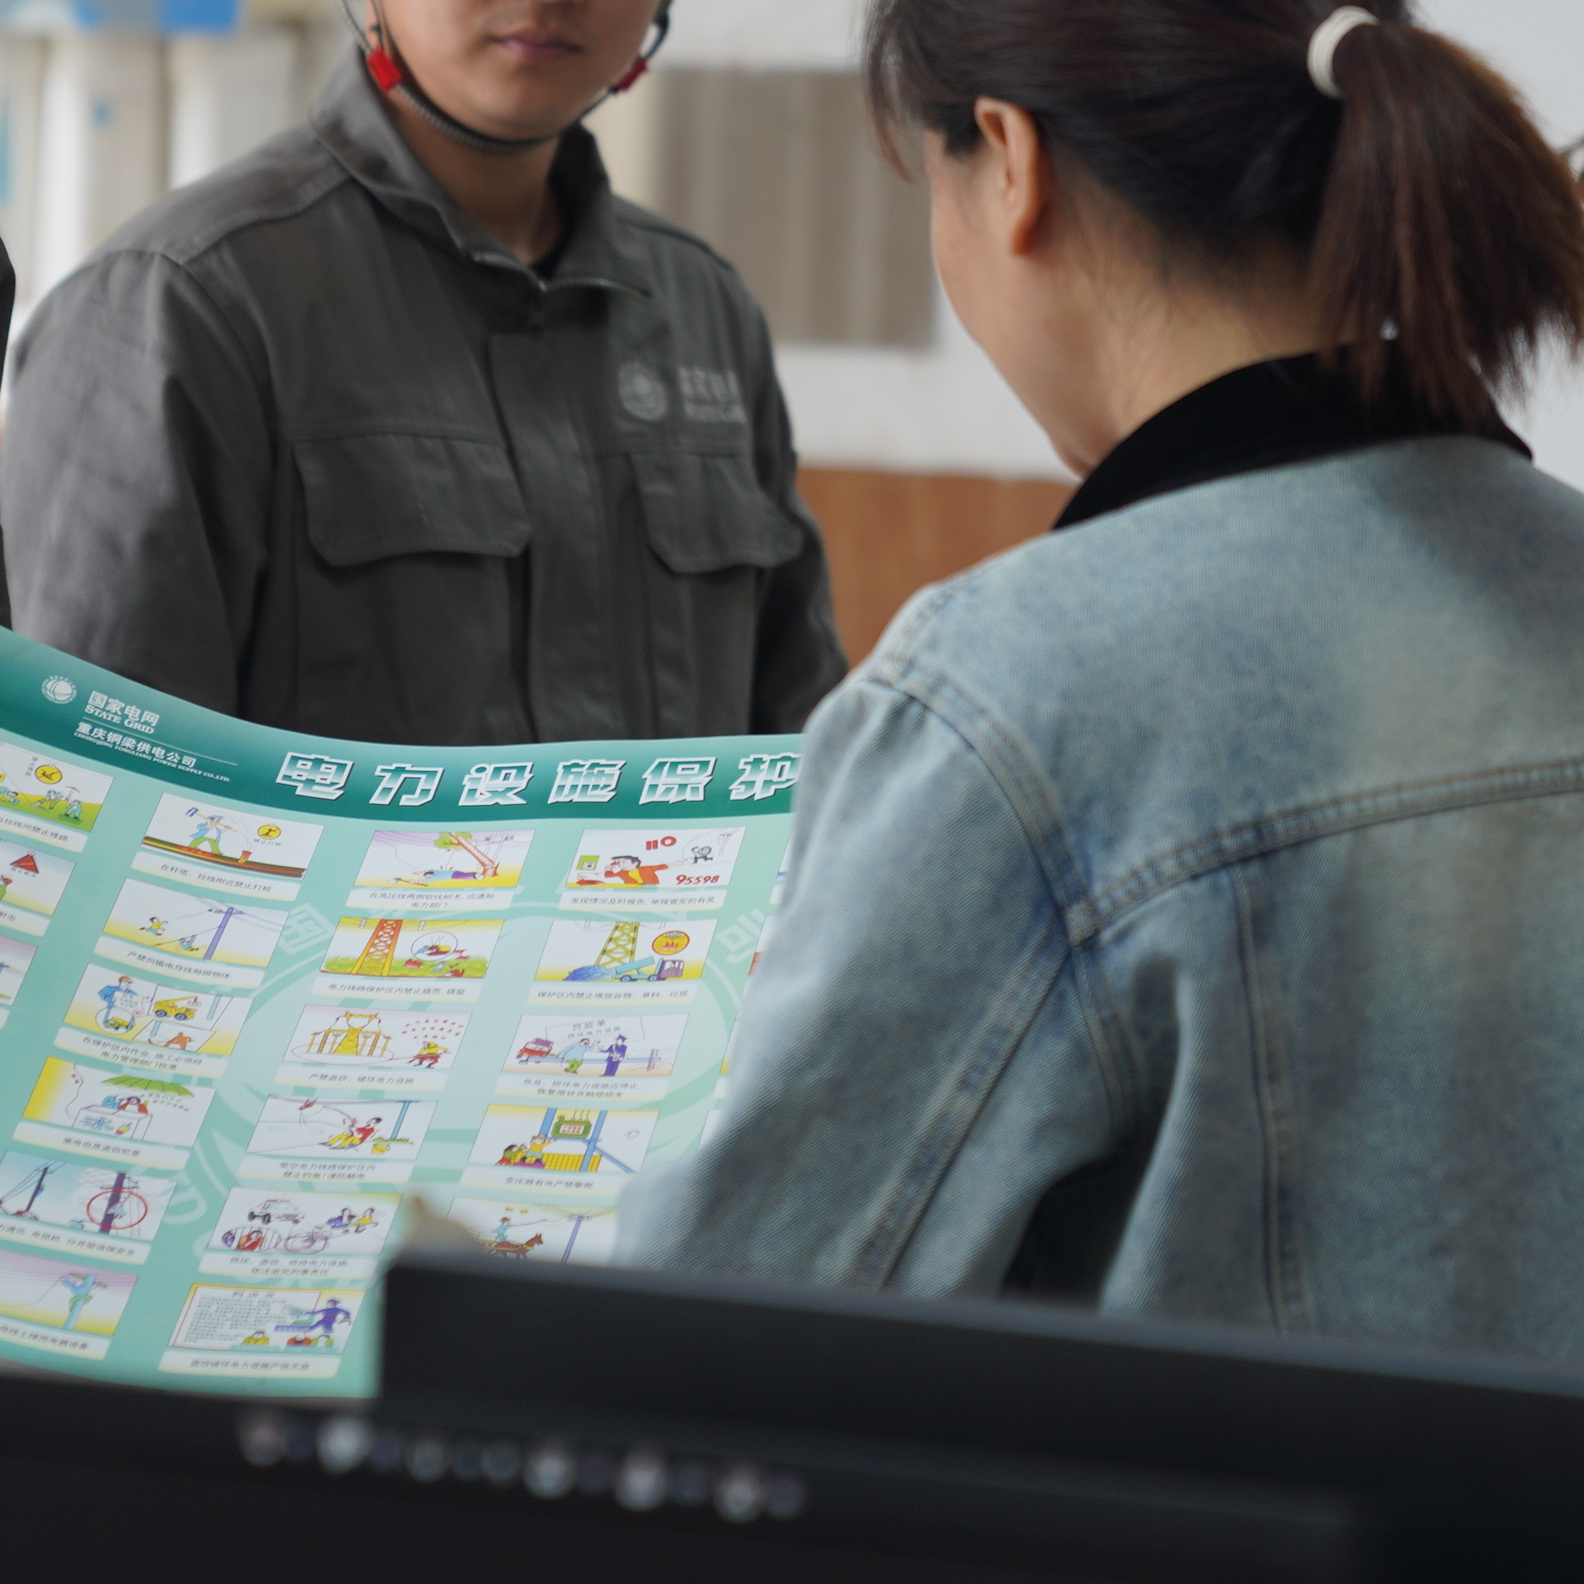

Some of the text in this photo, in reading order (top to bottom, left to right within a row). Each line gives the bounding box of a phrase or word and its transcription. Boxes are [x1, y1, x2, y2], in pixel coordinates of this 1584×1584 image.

[85, 704, 155, 734] STATE GRID
[88, 690, 160, 727] 国家电网
[75, 721, 197, 768] 重庆铜梁供电公司
[275, 750, 801, 808] 电力设施保护
[645, 836, 677, 850] 110
[676, 874, 720, 885] 95598
